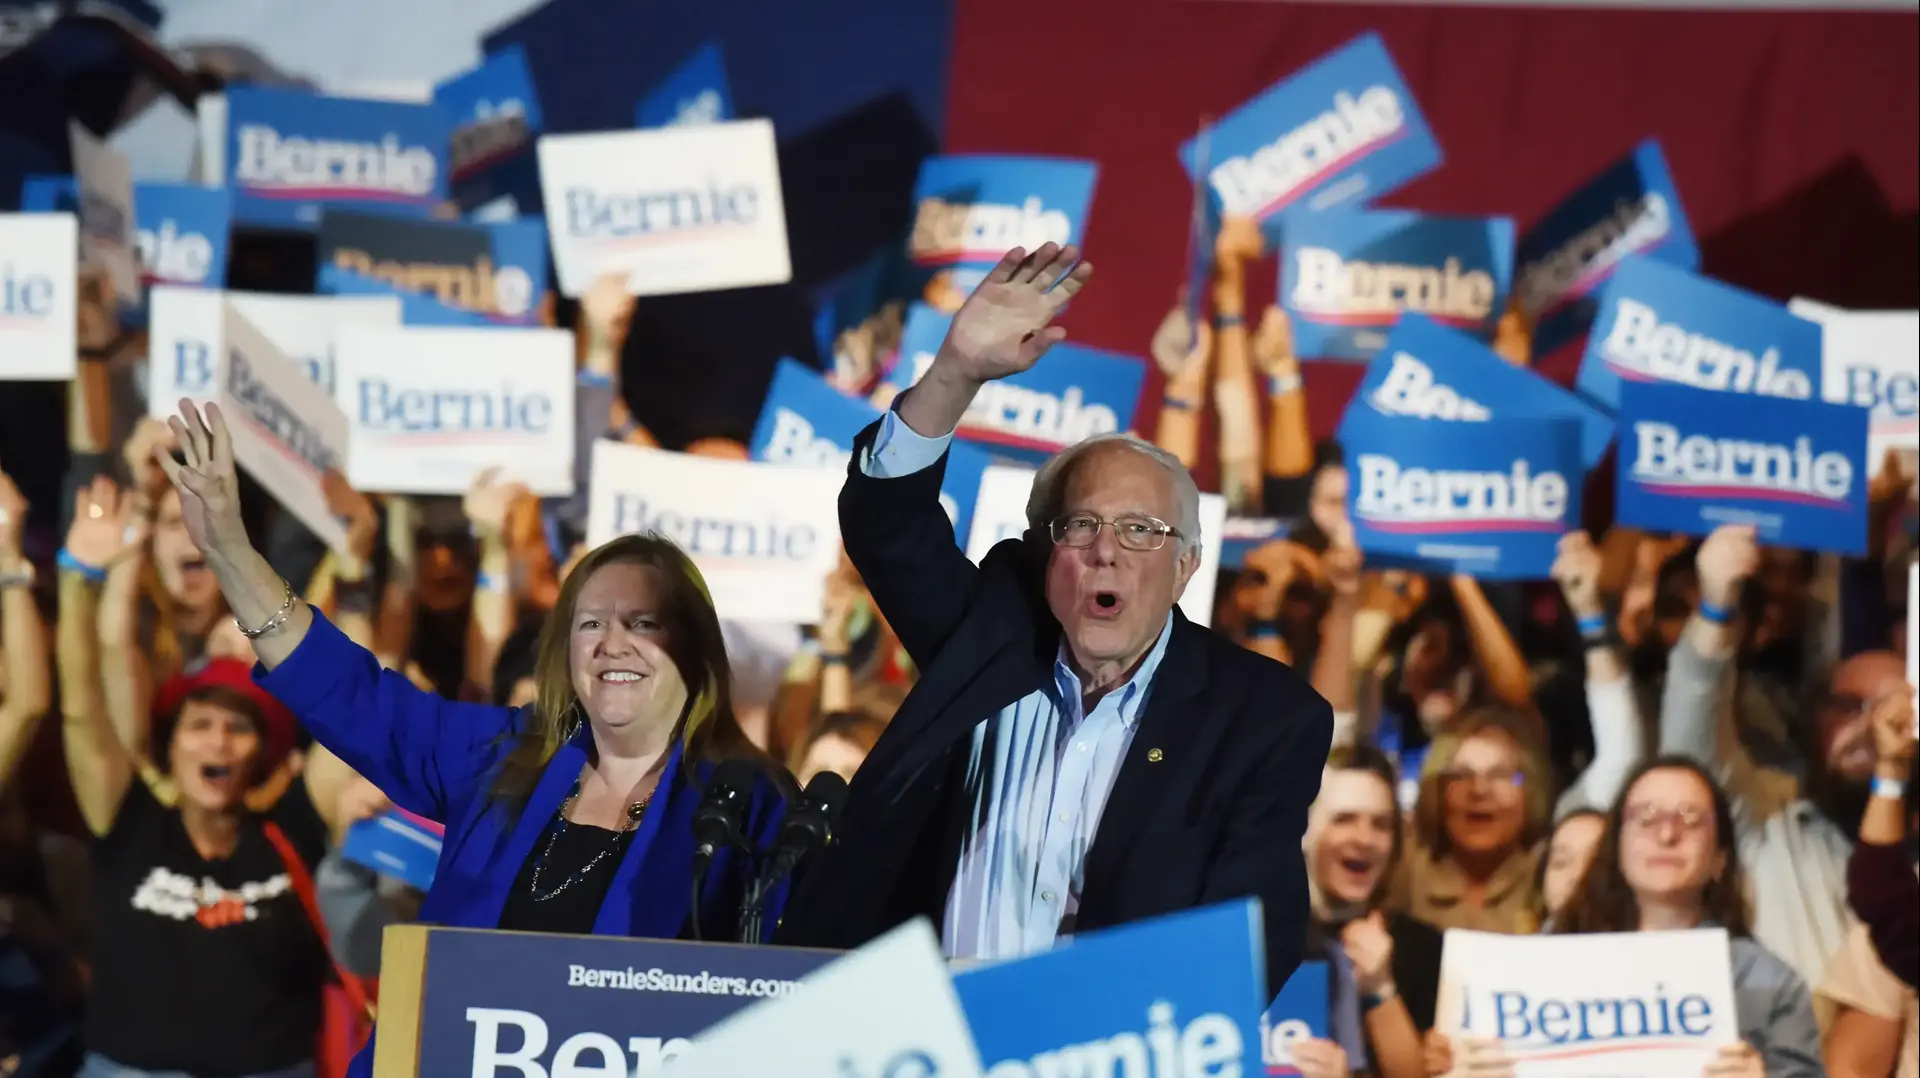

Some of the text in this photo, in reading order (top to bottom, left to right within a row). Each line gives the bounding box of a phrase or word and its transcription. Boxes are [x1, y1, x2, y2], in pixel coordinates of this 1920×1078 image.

[235, 124, 436, 196] Bernie
[1207, 84, 1405, 217] Bernie
[564, 172, 760, 239] Bernie
[912, 195, 1071, 255] Bernie
[1291, 246, 1496, 319] Bernie
[1600, 298, 1812, 401] Bernie
[357, 376, 552, 433] Bernie
[1356, 454, 1569, 524] Bernie
[1632, 420, 1854, 501] Bernie
[612, 490, 817, 561] Bernie
[1491, 982, 1714, 1045] Bernie
